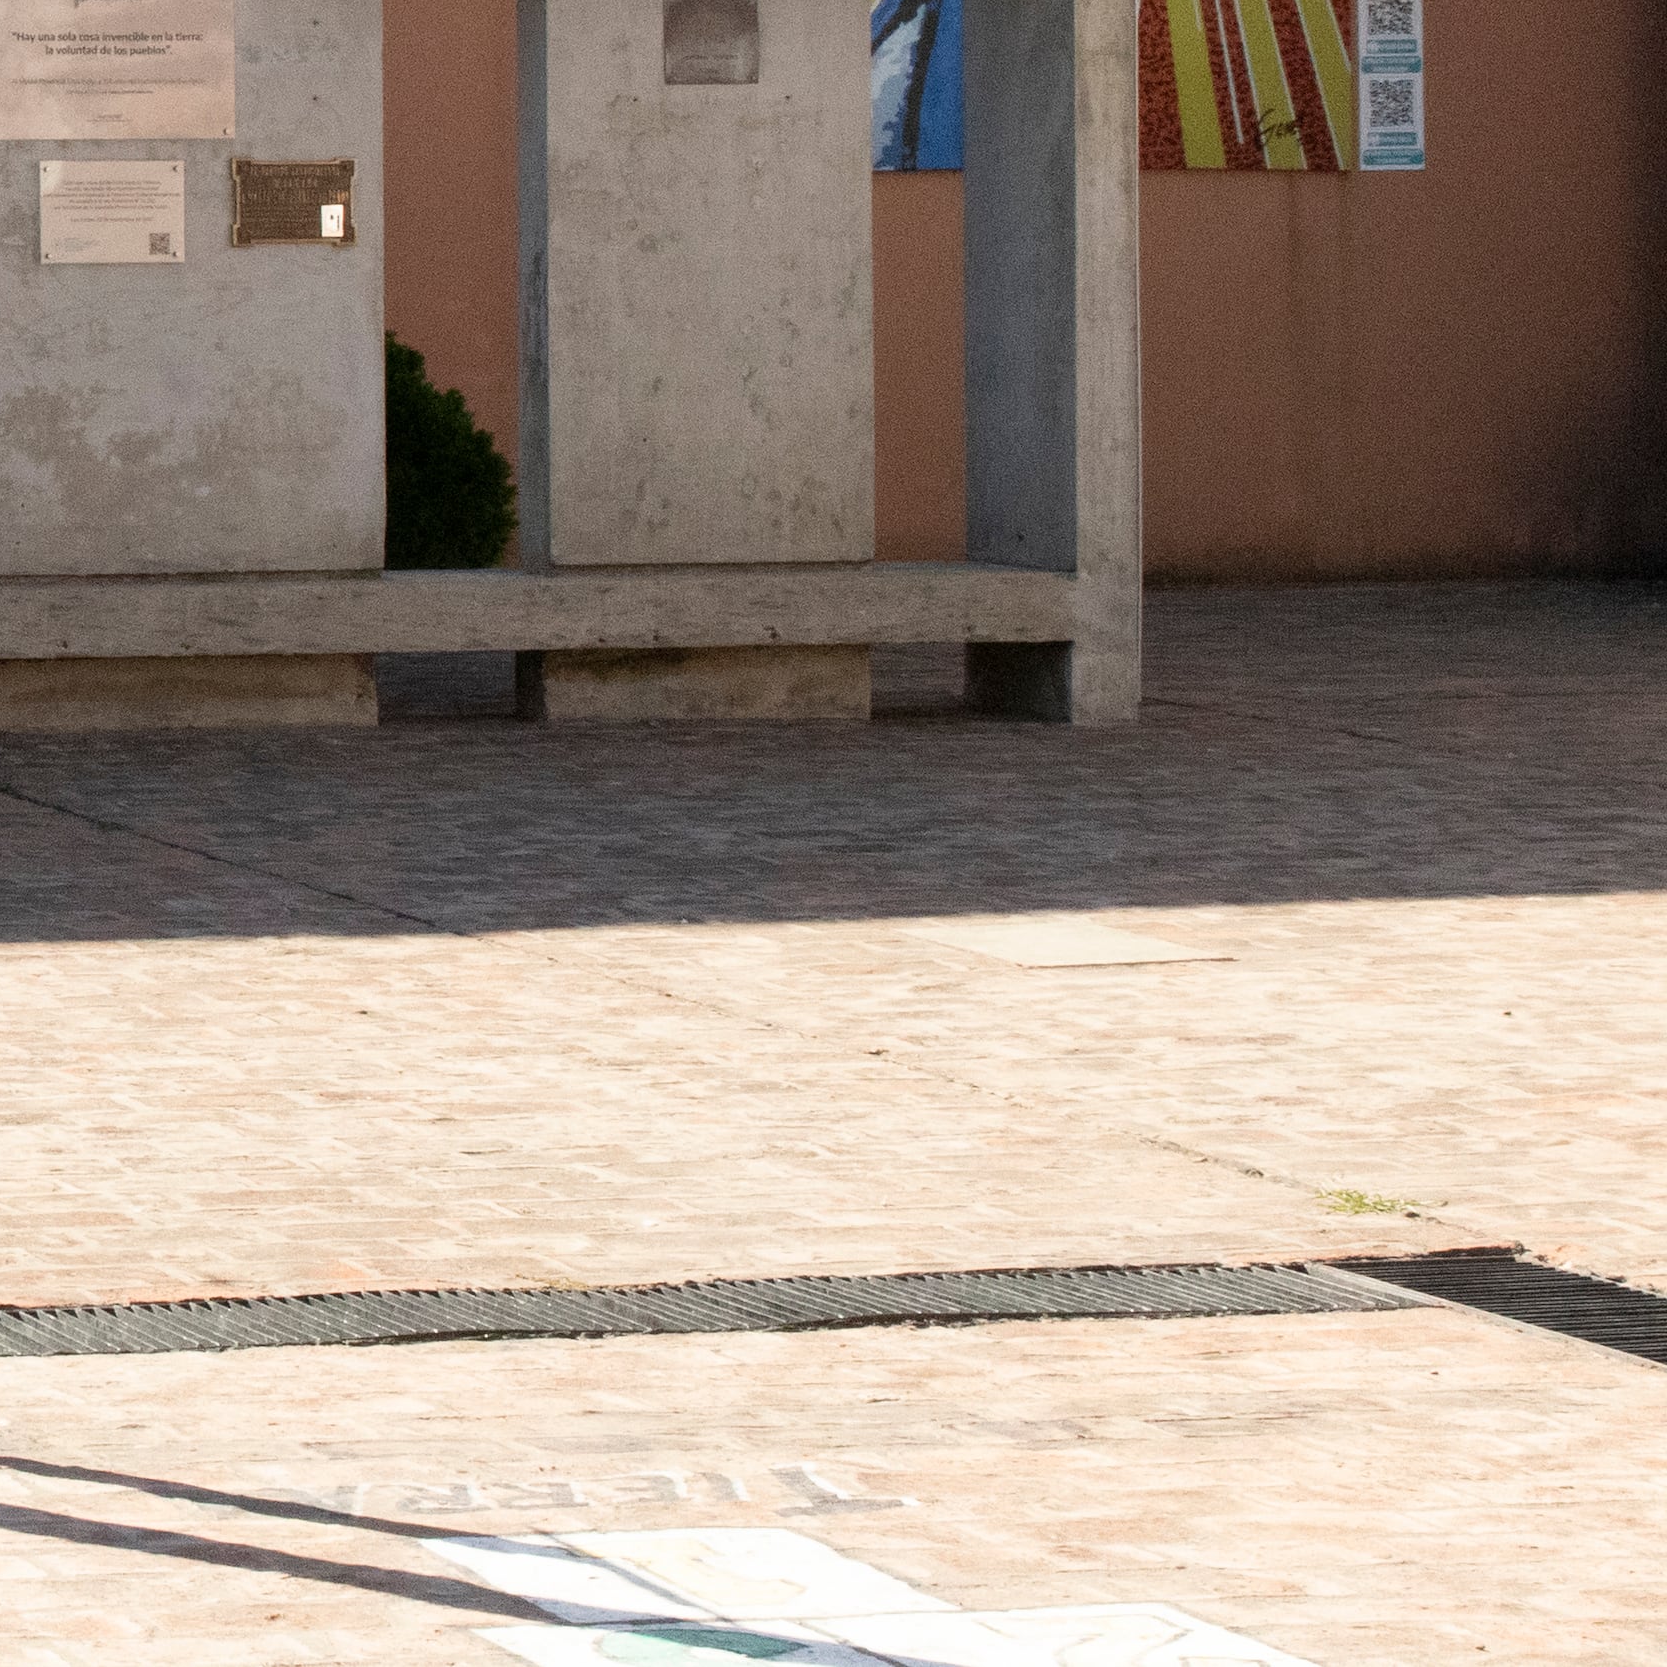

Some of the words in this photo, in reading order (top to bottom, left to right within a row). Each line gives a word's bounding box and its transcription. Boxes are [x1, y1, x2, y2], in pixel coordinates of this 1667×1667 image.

[38, 34, 56, 42] una
[58, 32, 77, 42] sola
[79, 33, 100, 42] cosa
[102, 32, 150, 42] invencible
[152, 34, 164, 42] en
[165, 32, 173, 42] la
[45, 46, 54, 55] la
[55, 45, 98, 55] voluntad
[100, 45, 112, 55] de
[114, 45, 128, 55] los
